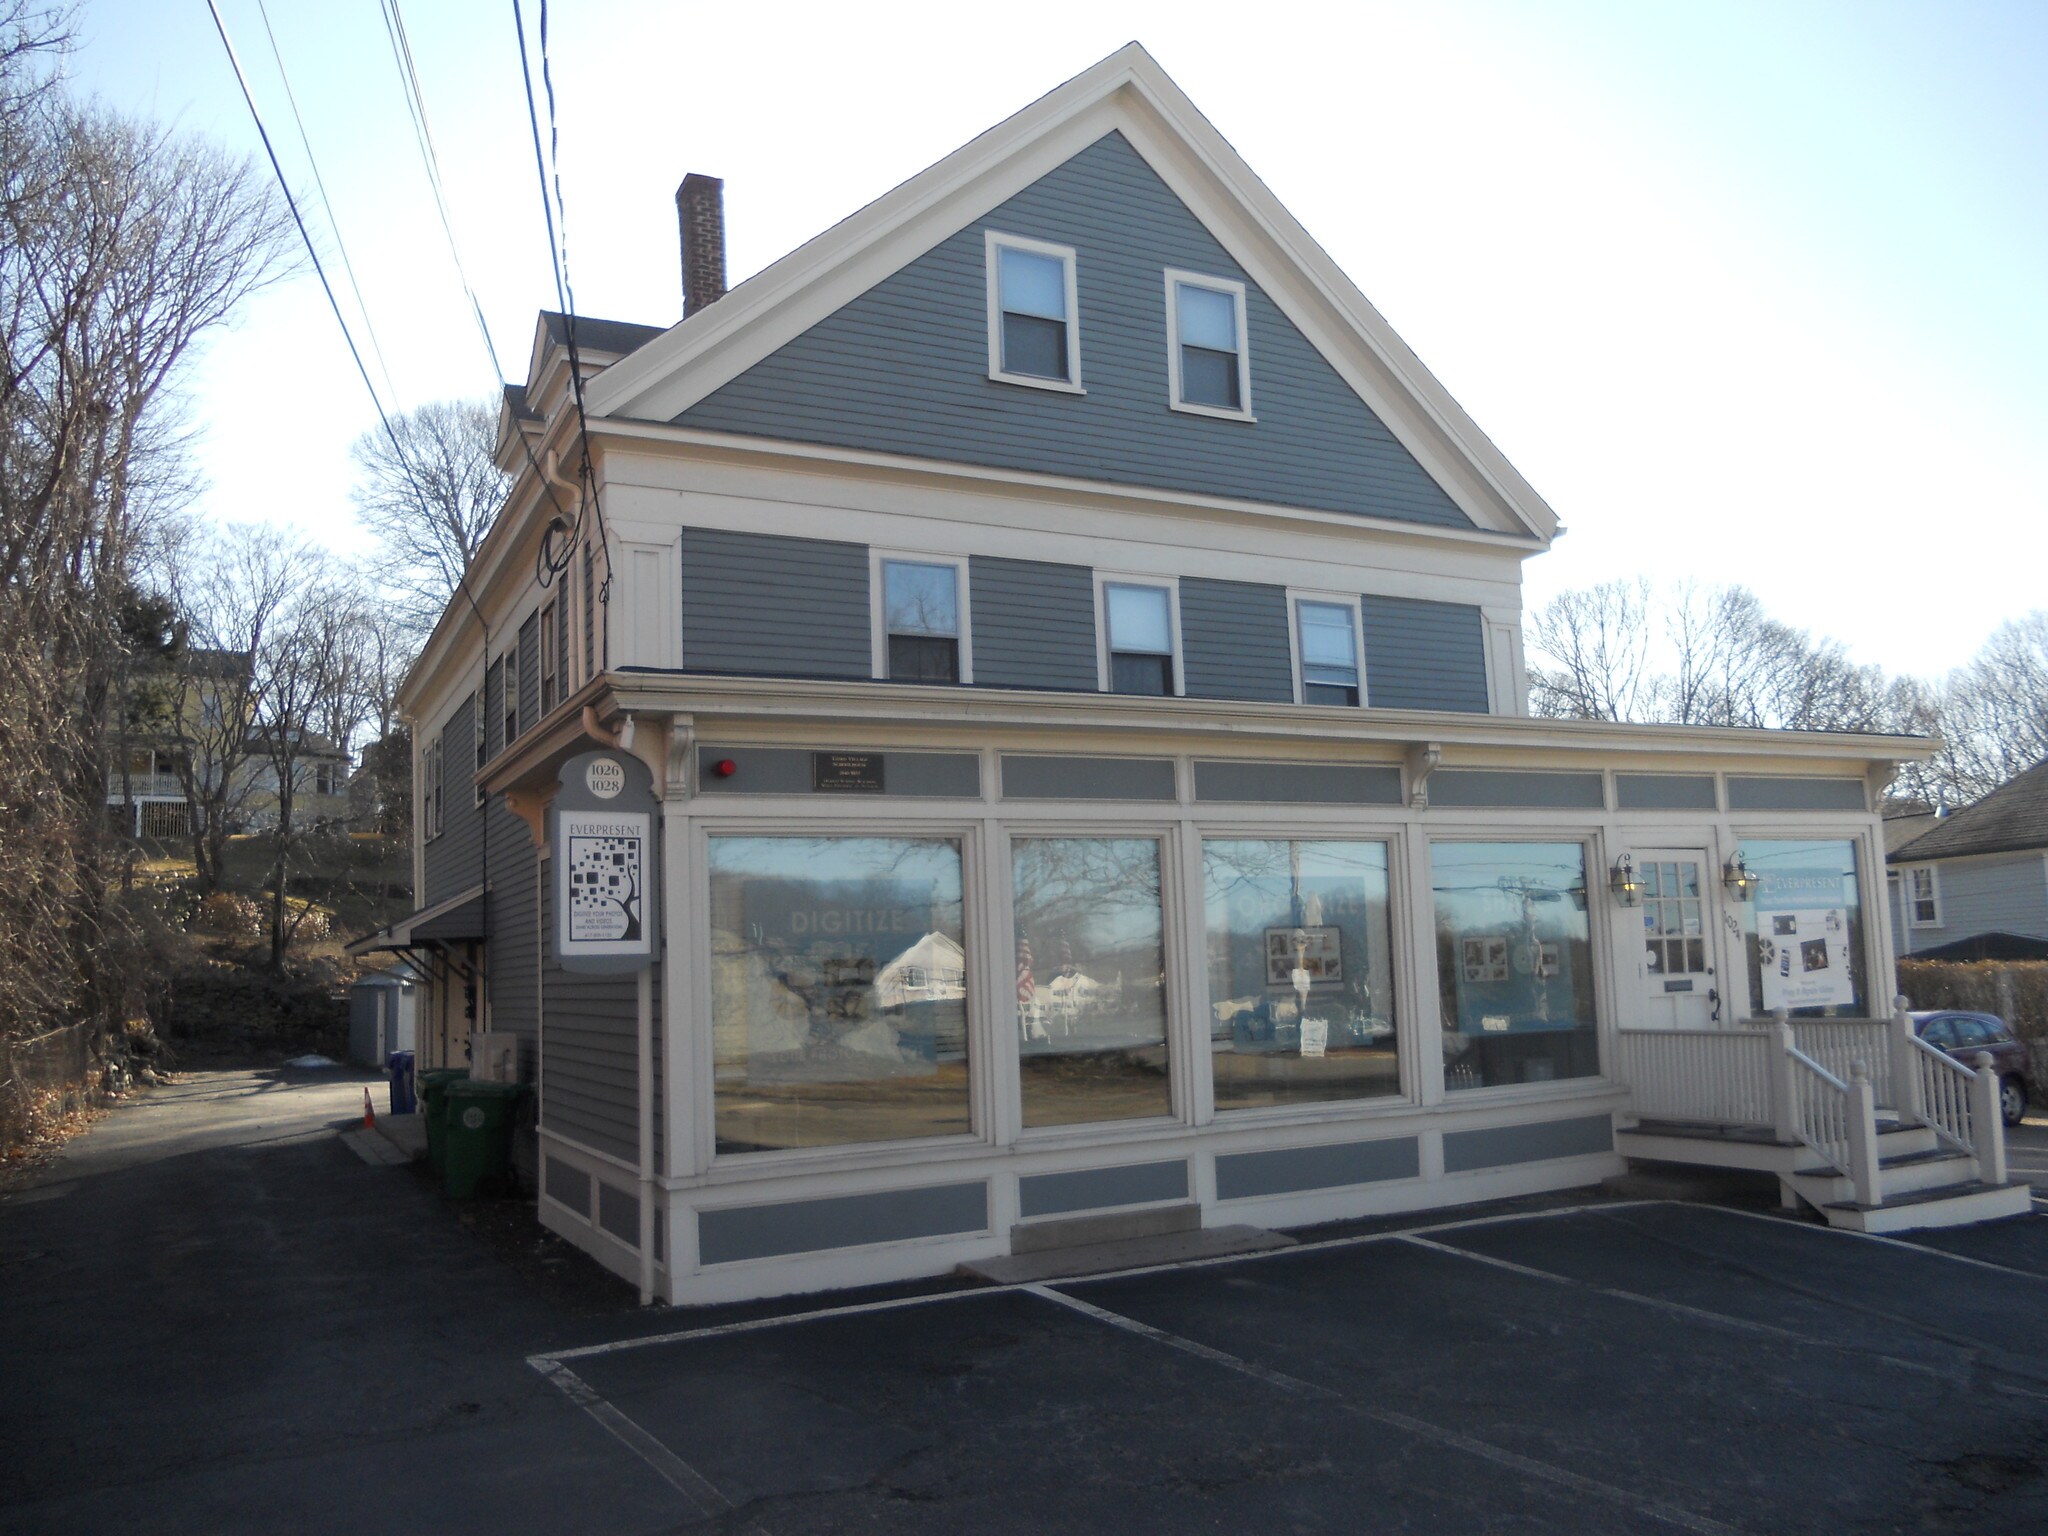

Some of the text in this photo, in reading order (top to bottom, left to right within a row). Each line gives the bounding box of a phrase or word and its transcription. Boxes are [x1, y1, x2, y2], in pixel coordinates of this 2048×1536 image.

[591, 765, 619, 777] 1026
[591, 780, 620, 792] 1028
[570, 824, 640, 836] EVERPRESENT
[791, 909, 903, 933] DIGITIZE
